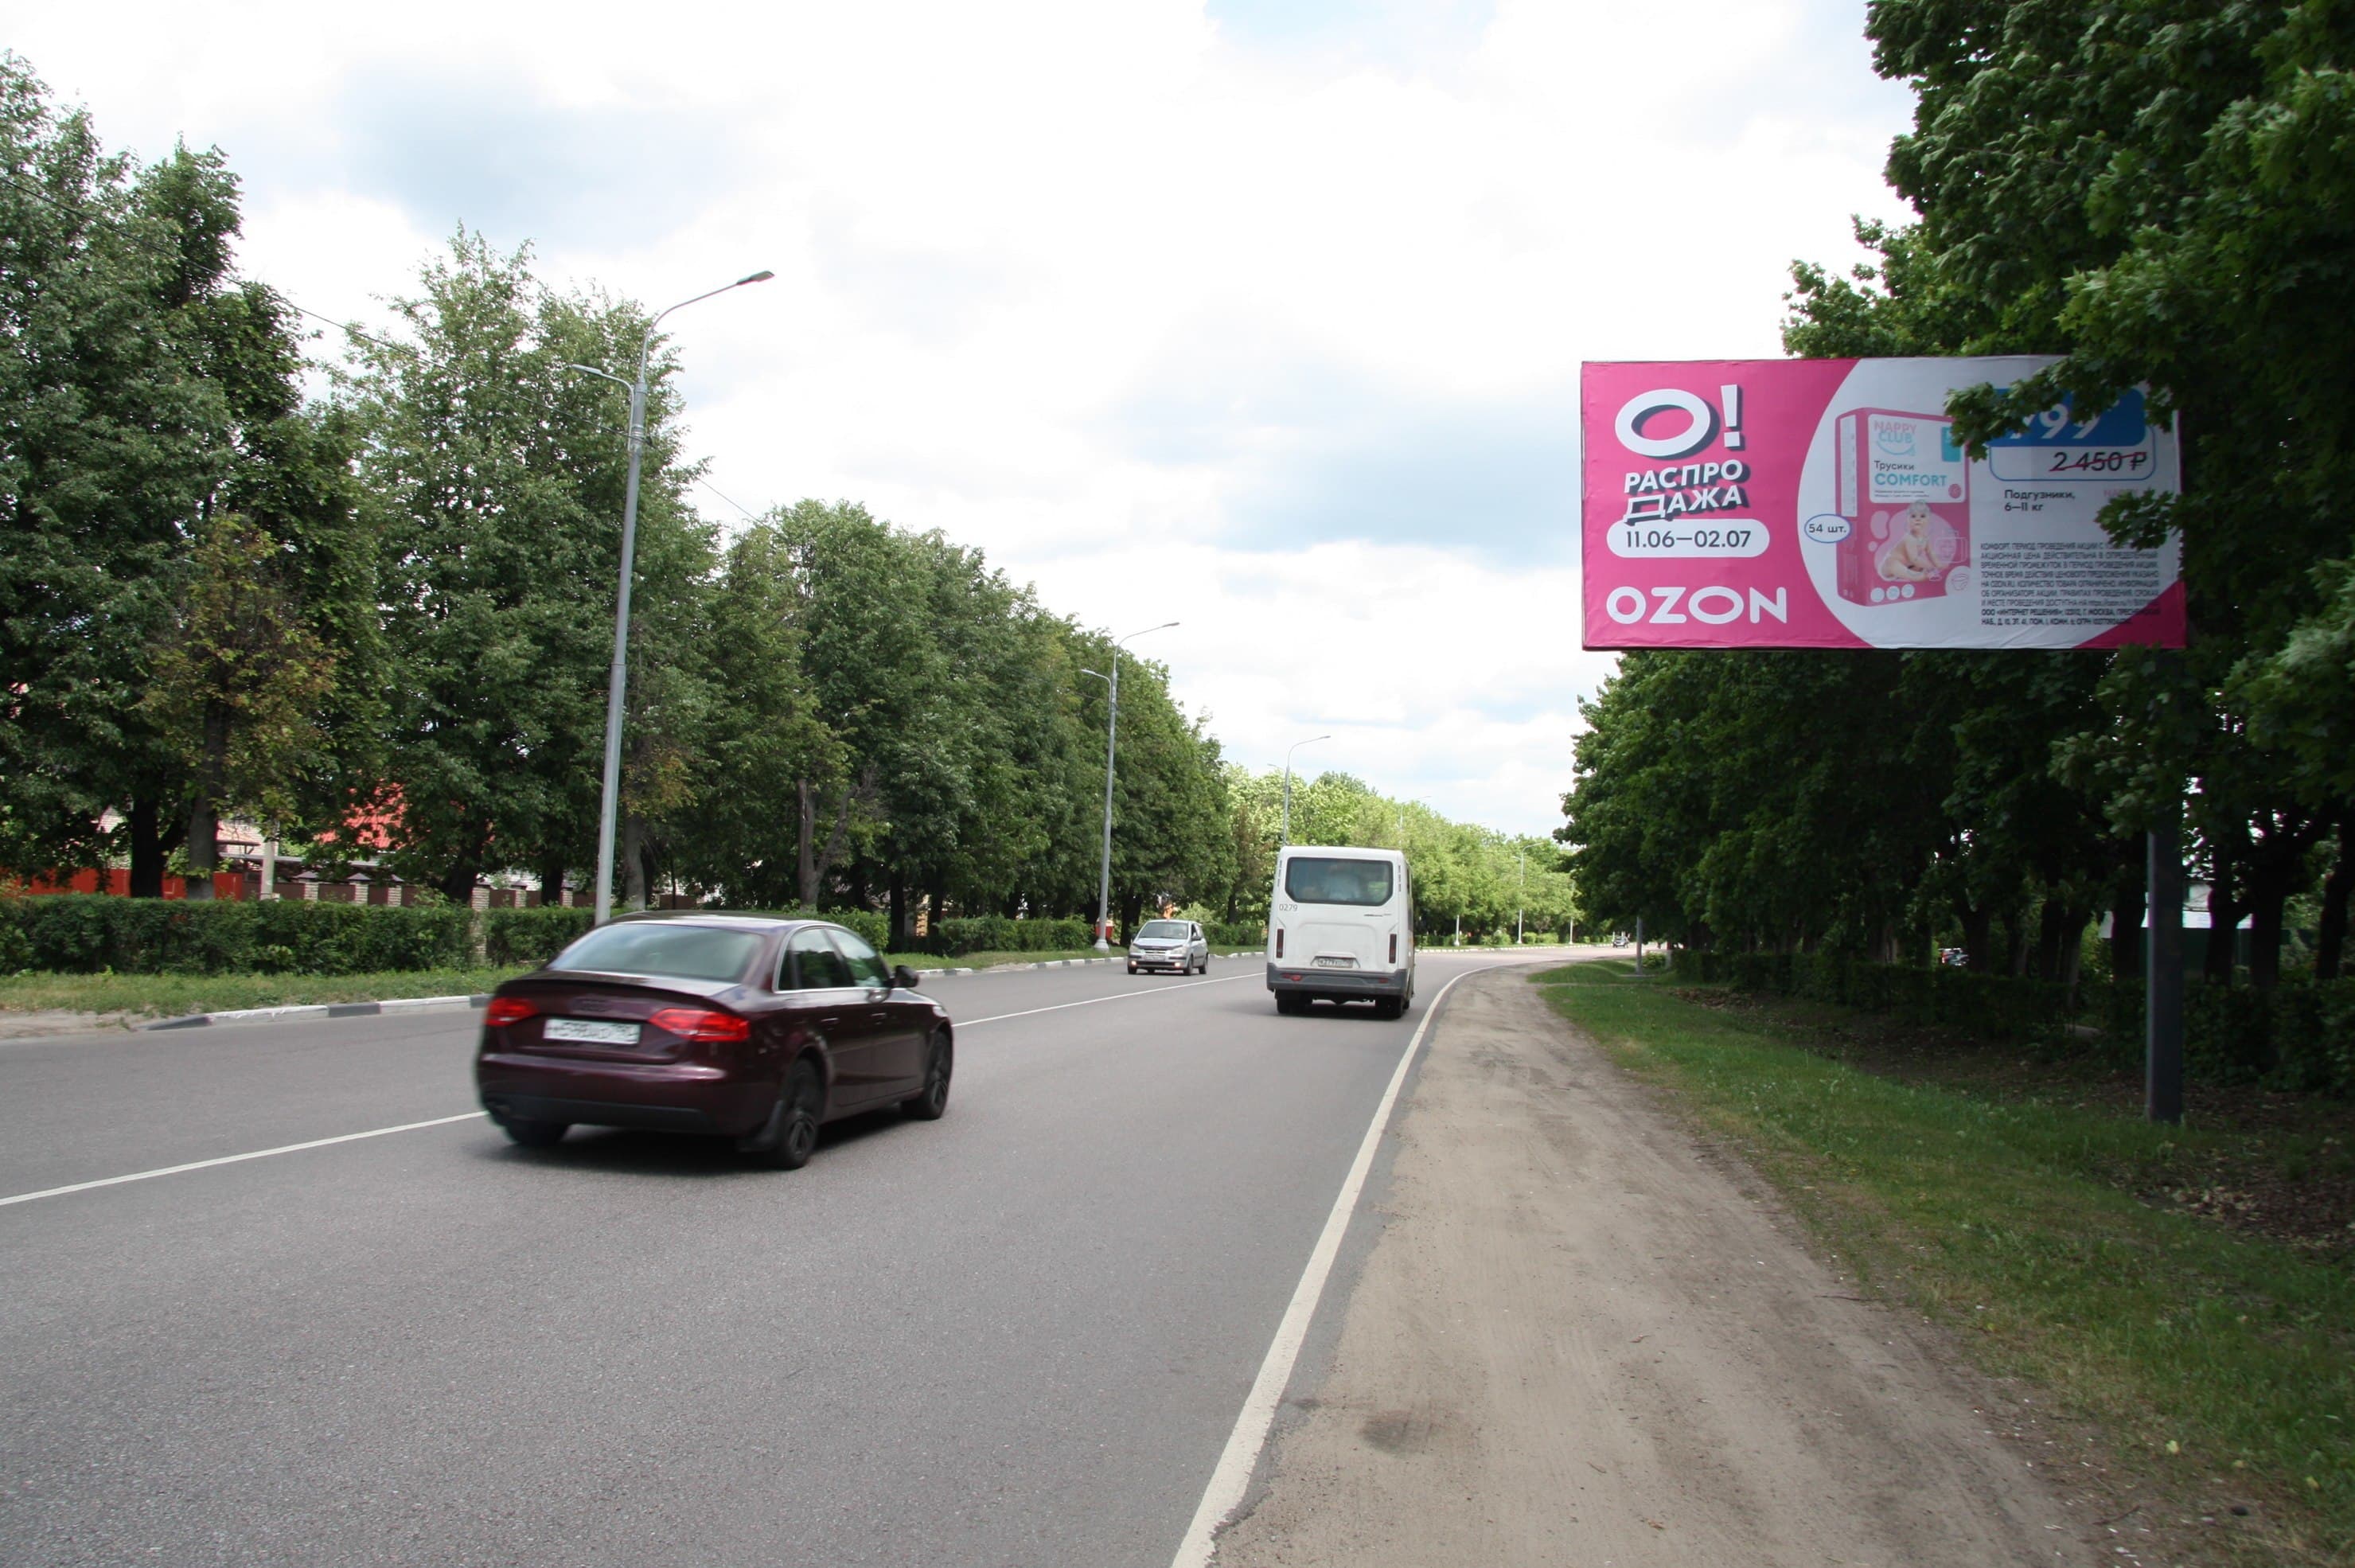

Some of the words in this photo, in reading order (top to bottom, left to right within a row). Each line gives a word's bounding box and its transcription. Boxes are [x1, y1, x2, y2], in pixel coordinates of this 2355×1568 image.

[1873, 420, 1916, 434] NAPPY
[1878, 431, 1913, 444] CLUB
[1873, 460, 1915, 471] Трусики
[1624, 459, 1750, 493] РАСПРО
[1874, 473, 1948, 486] COMFORT
[2004, 490, 2075, 501] Подгузники,
[1624, 485, 1749, 525] ДАЖА
[1808, 523, 1823, 534] 54
[1827, 525, 1847, 534] шт.
[1606, 586, 1788, 625] OZON
